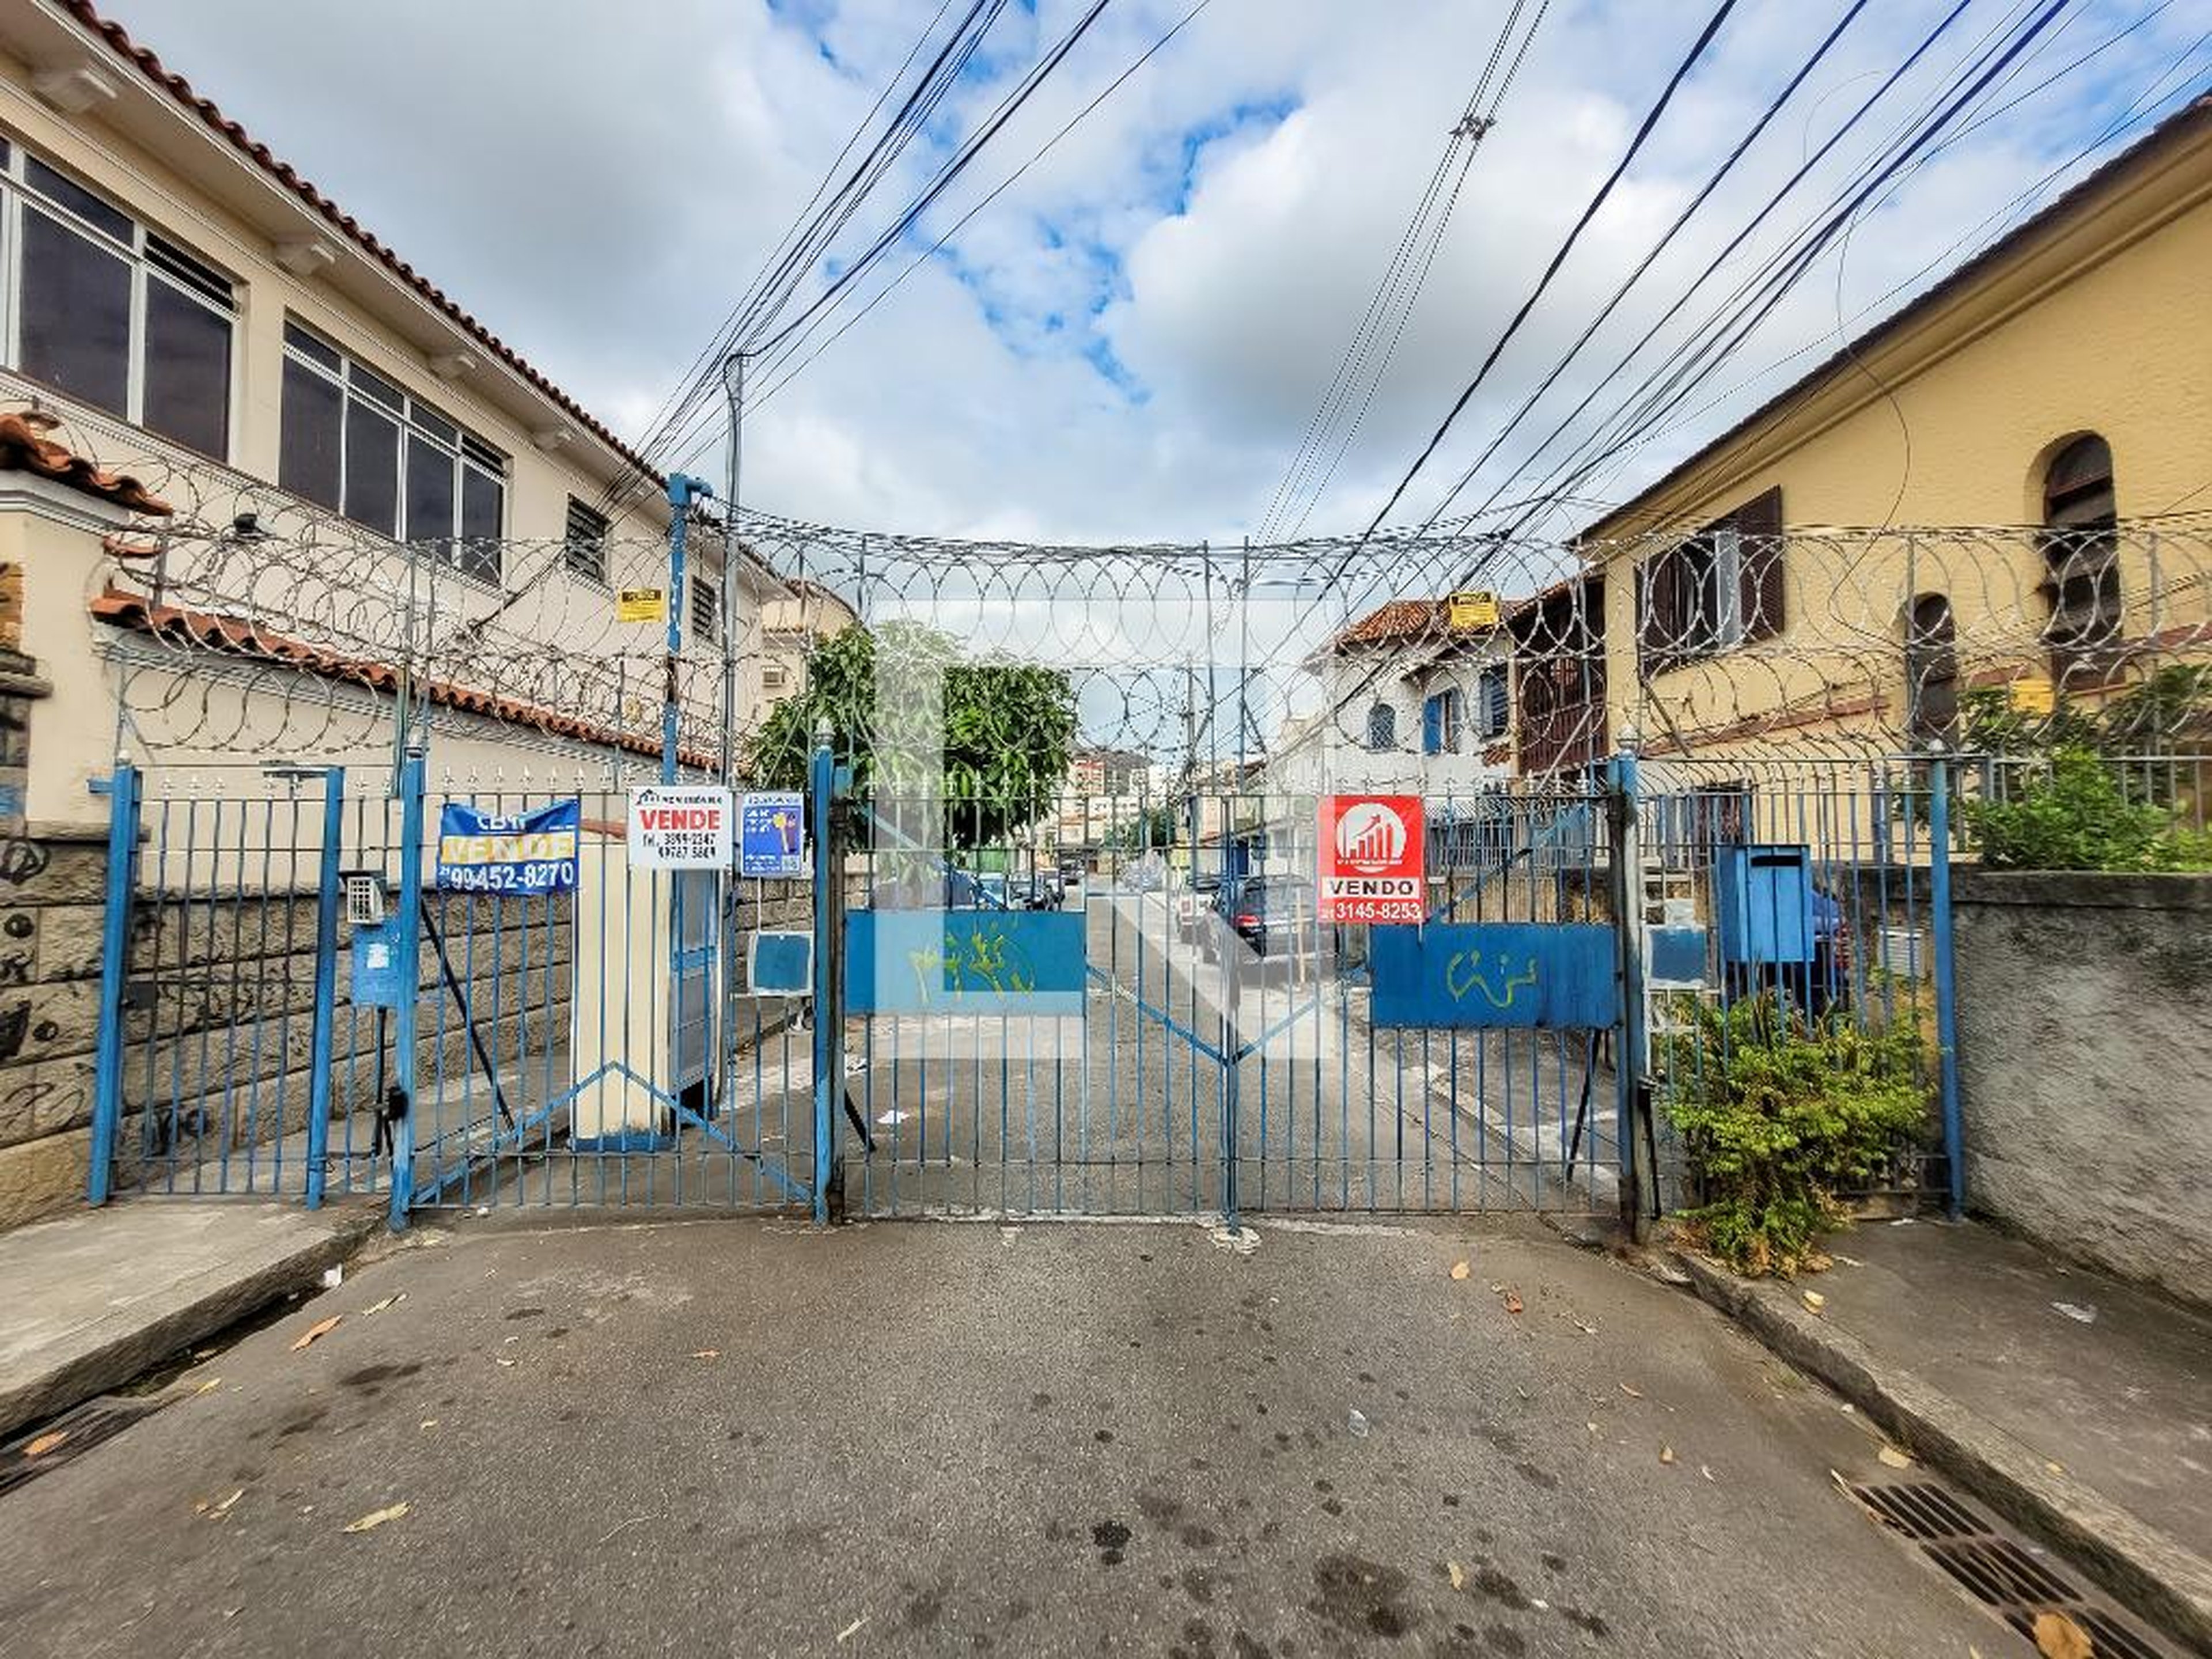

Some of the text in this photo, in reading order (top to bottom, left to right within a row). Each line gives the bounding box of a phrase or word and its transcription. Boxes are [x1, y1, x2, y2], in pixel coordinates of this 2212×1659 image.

[639, 809, 720, 830] VENDE
[445, 833, 574, 862] VENDE
[450, 862, 574, 891] 99452-8270
[1330, 880, 1414, 895] VENDO
[1336, 902, 1422, 919] 3145-8253
